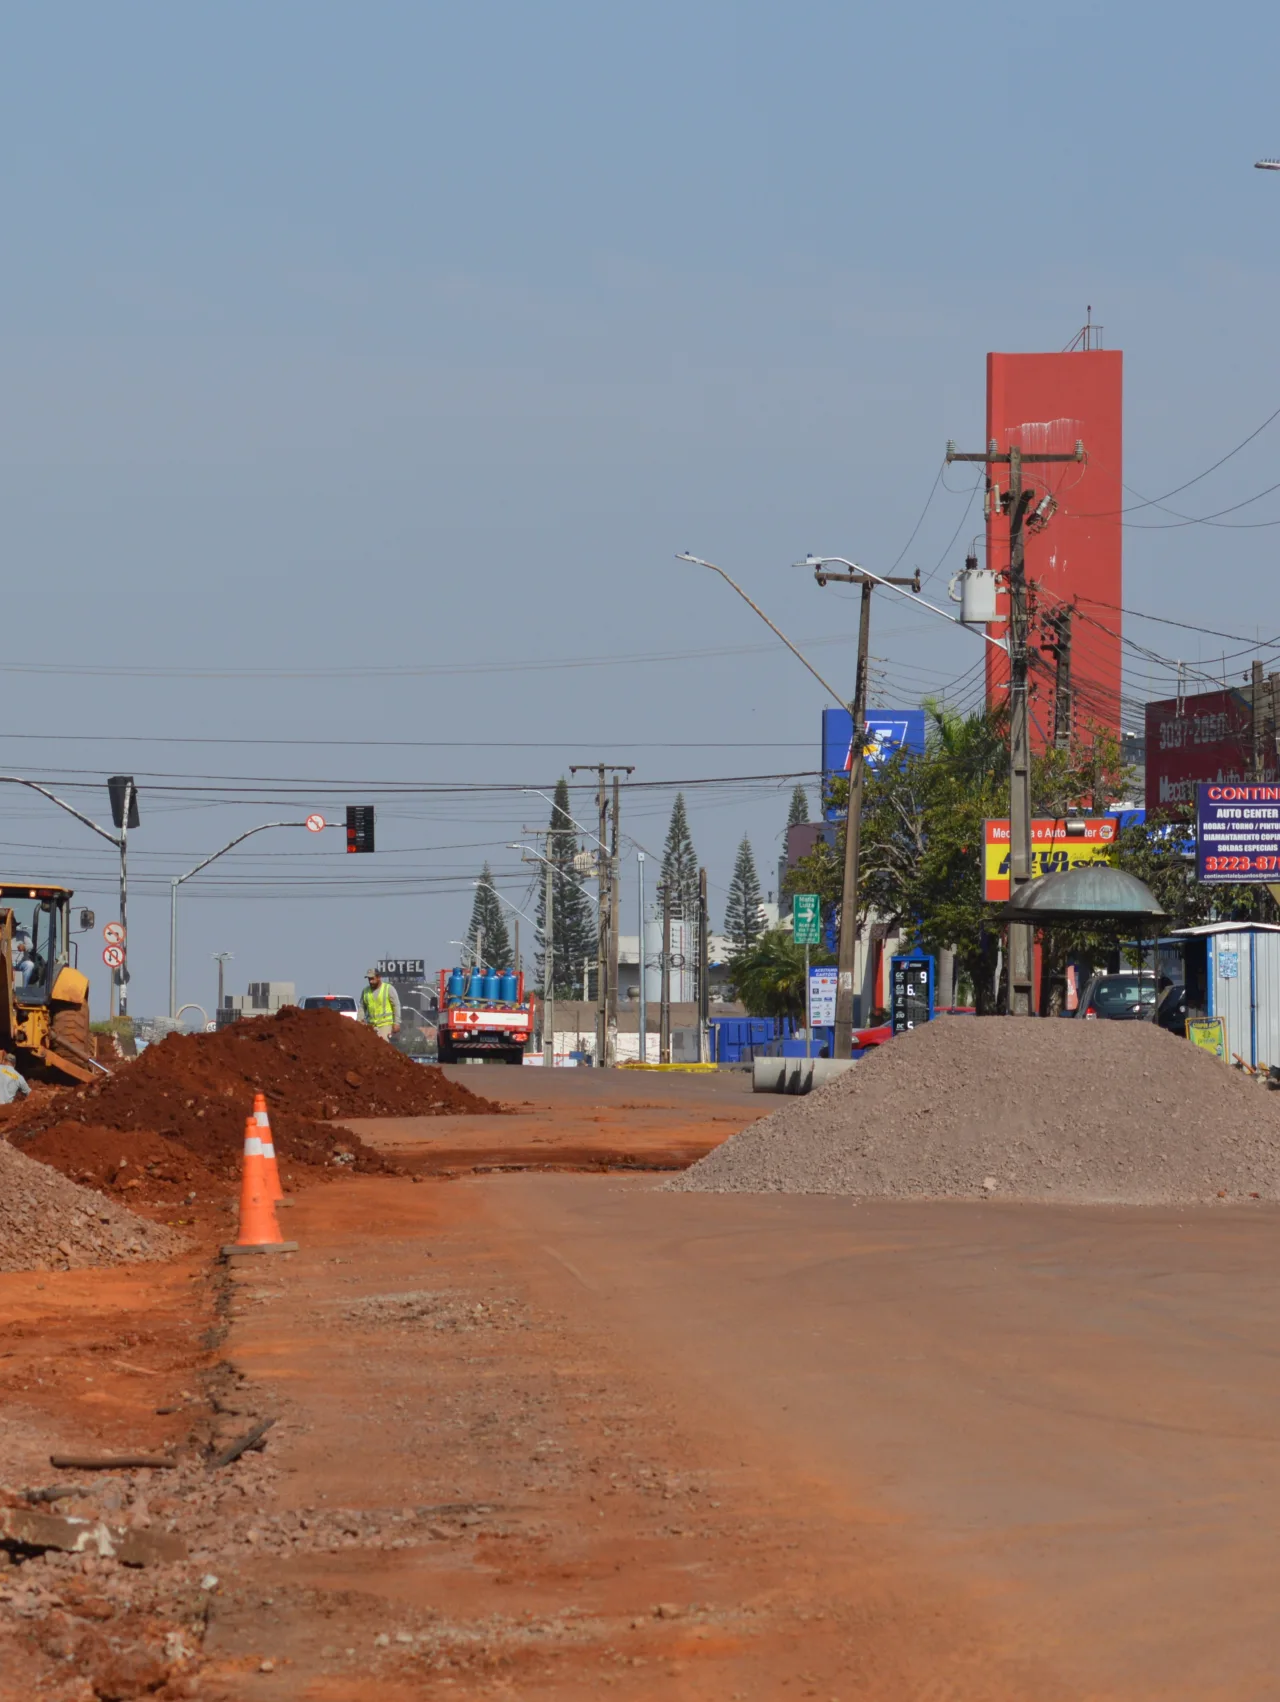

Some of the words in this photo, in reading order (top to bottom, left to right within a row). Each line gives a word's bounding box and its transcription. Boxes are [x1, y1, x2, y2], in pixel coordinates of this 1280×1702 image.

[1208, 787, 1280, 800] CONTIN
[1216, 808, 1242, 819] AUTO
[1243, 808, 1279, 818] CENTER
[1044, 828, 1066, 838] Auto
[1217, 844, 1243, 852] SOLDAS
[1244, 844, 1279, 852] ESPECIAIS
[377, 961, 424, 974] HOTEL
[920, 971, 927, 983] 9
